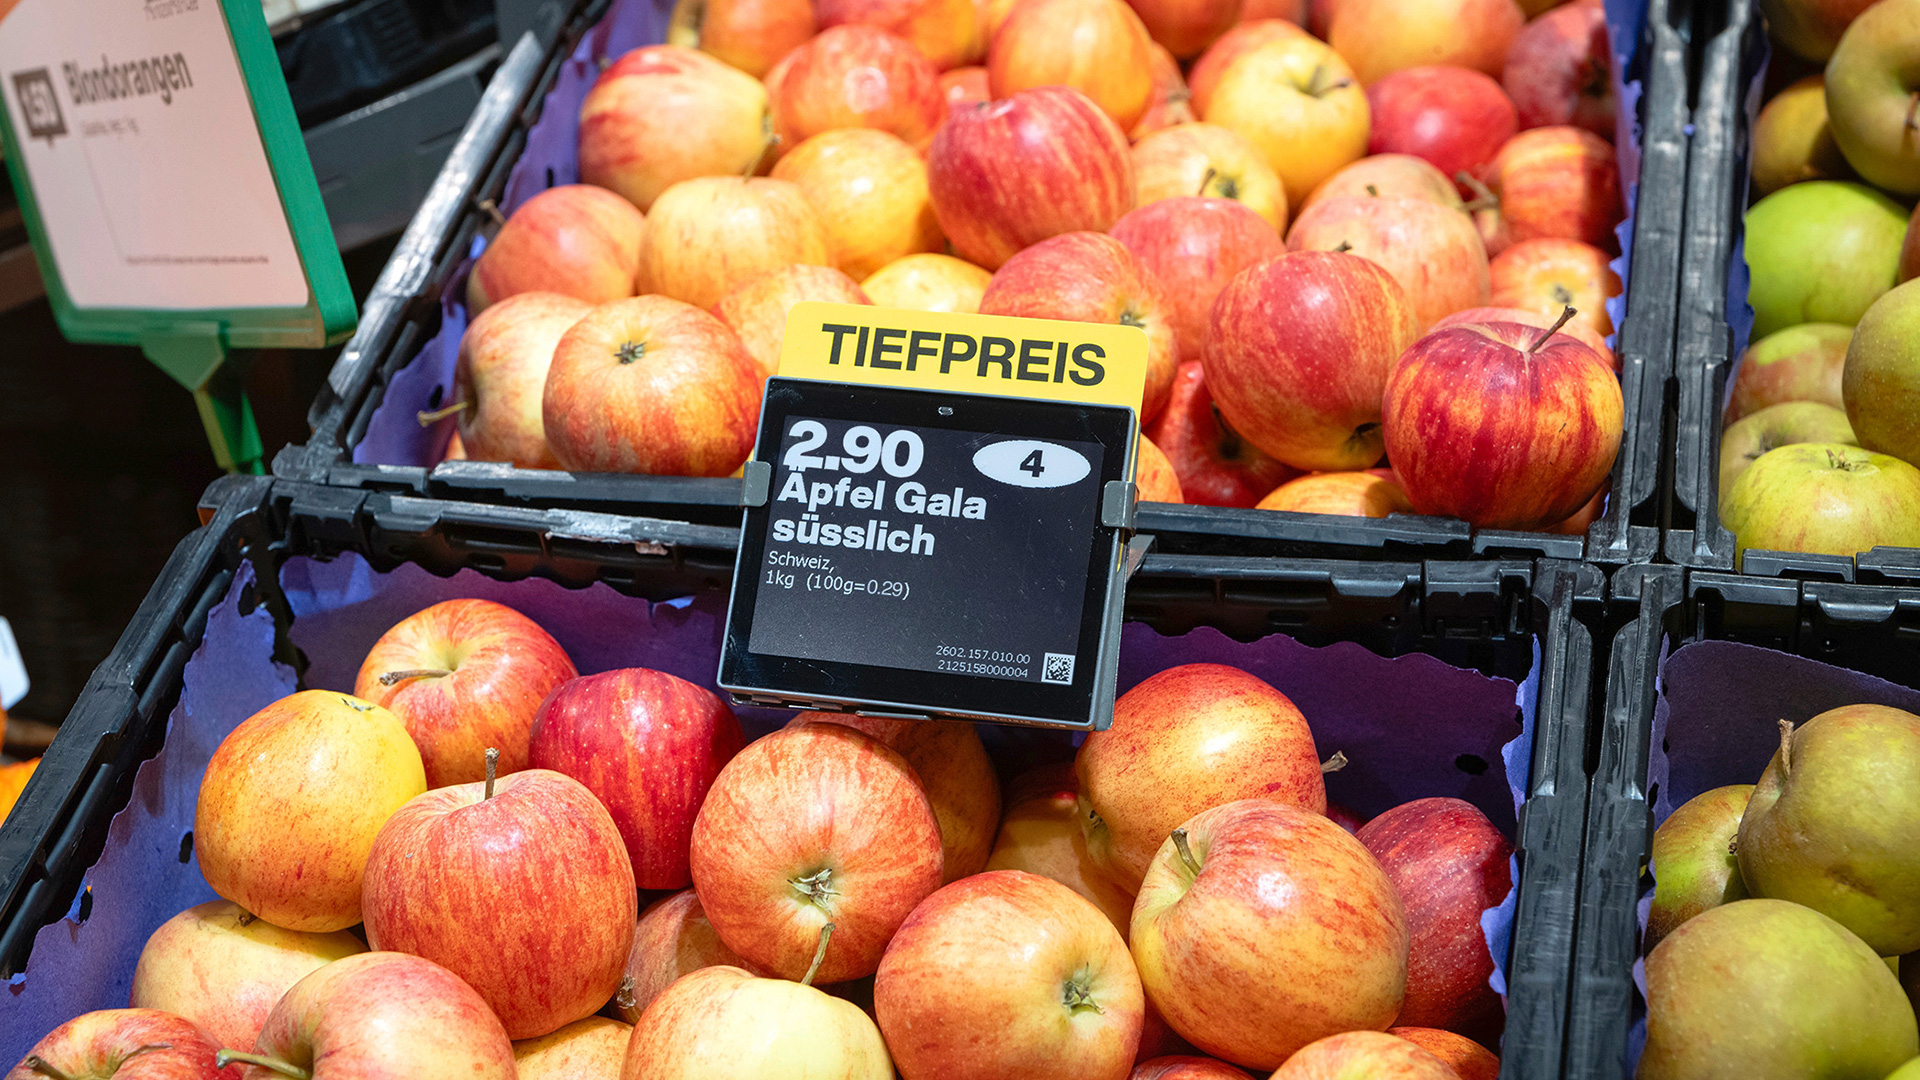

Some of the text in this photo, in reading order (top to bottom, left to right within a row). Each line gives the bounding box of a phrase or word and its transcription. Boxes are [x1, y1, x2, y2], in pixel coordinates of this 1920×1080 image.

[822, 324, 1106, 386] TIEFPREIS
[782, 420, 924, 477] 2.90
[1020, 450, 1045, 477] 4
[777, 466, 987, 520] Äpfel Gala
[772, 514, 935, 556] süsslich
[768, 551, 835, 572] Schweiz,
[766, 571, 910, 600] 1kg (100g=0.29)
[936, 645, 1031, 664] 2602.157.010.00
[938, 659, 1028, 678] 2125158000004
